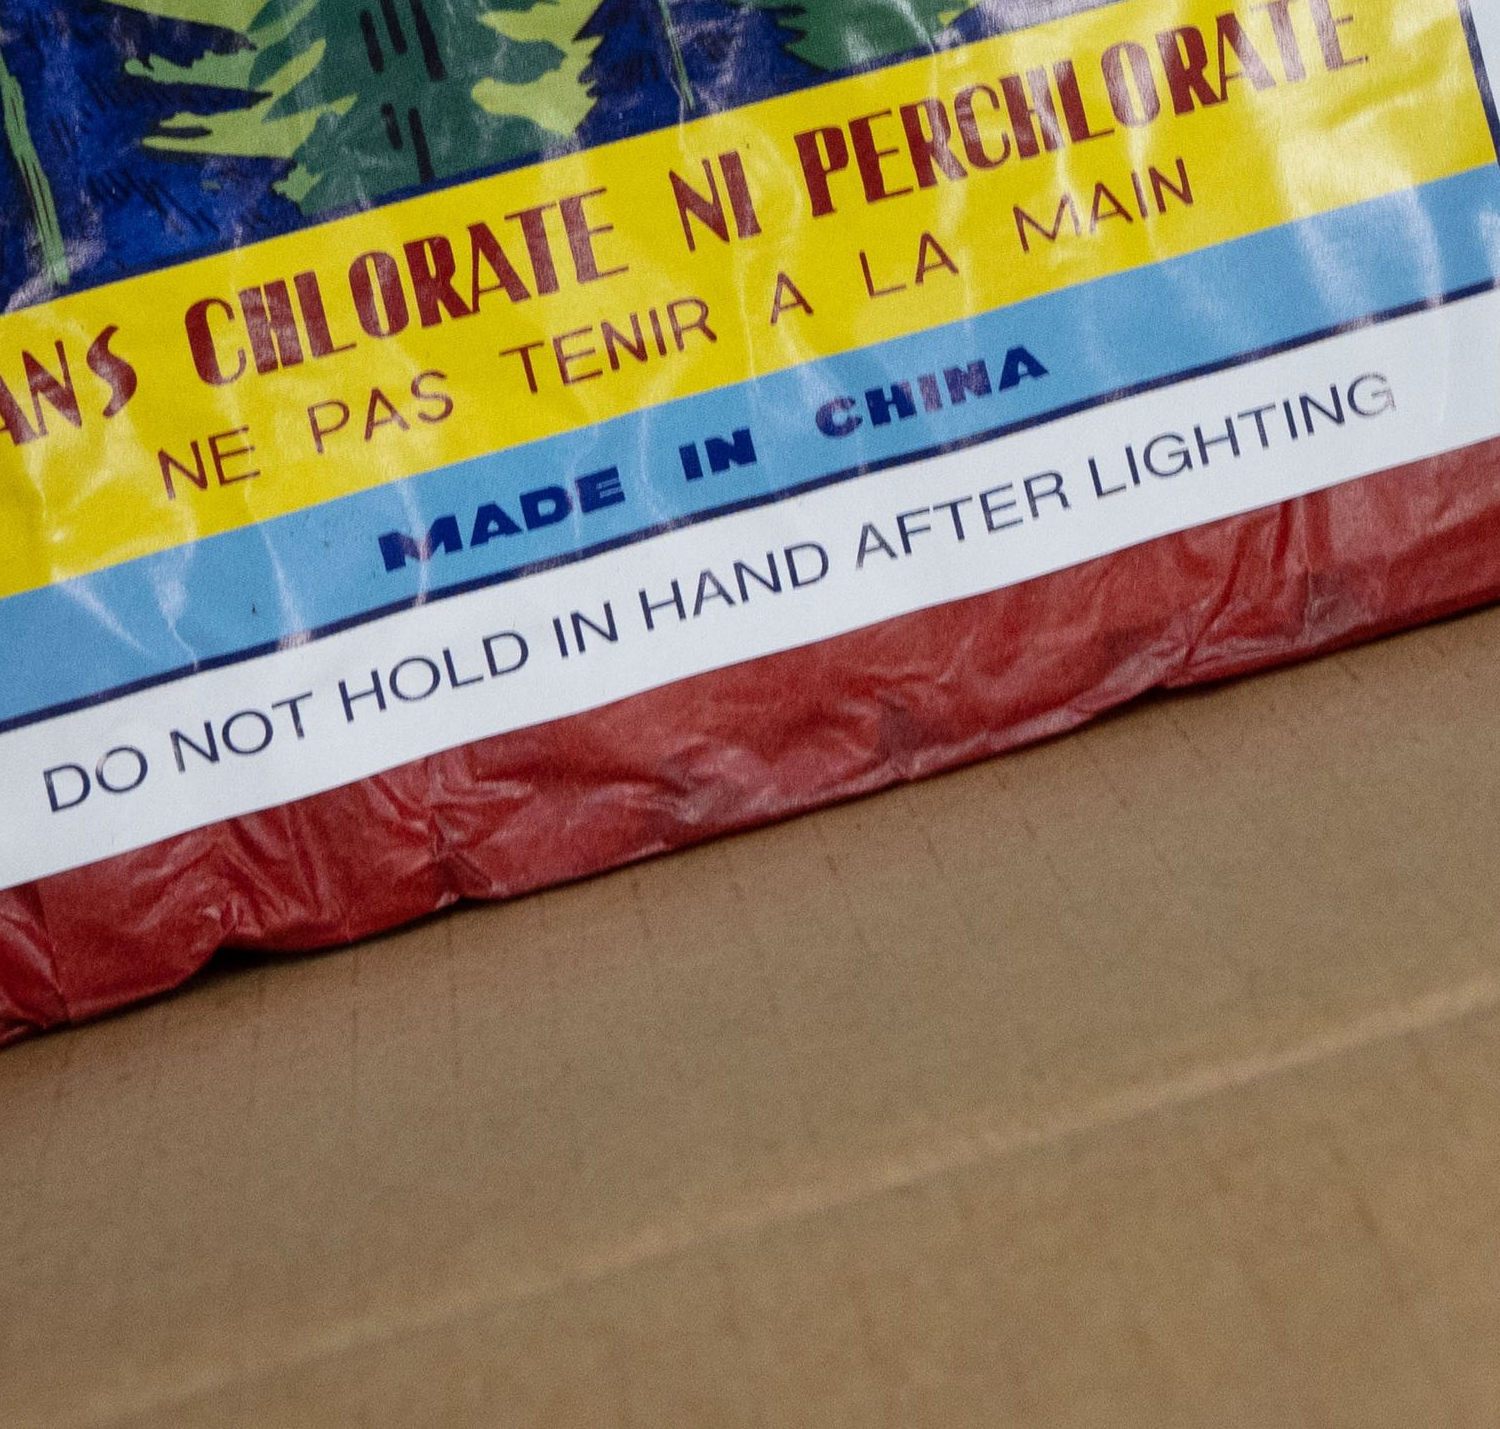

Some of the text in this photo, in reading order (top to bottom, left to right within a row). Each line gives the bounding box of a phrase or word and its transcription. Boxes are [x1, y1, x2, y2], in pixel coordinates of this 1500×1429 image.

[157, 158, 1194, 500] NE PAS TENIR A LA MAIN
[184, 188, 628, 386] CHLORATE
[669, 150, 762, 253] NI
[42, 373, 1395, 814] DO NOT HOLD IN HAND AFTER LIGHTING
[378, 347, 1050, 572] MADE IN CHINA
